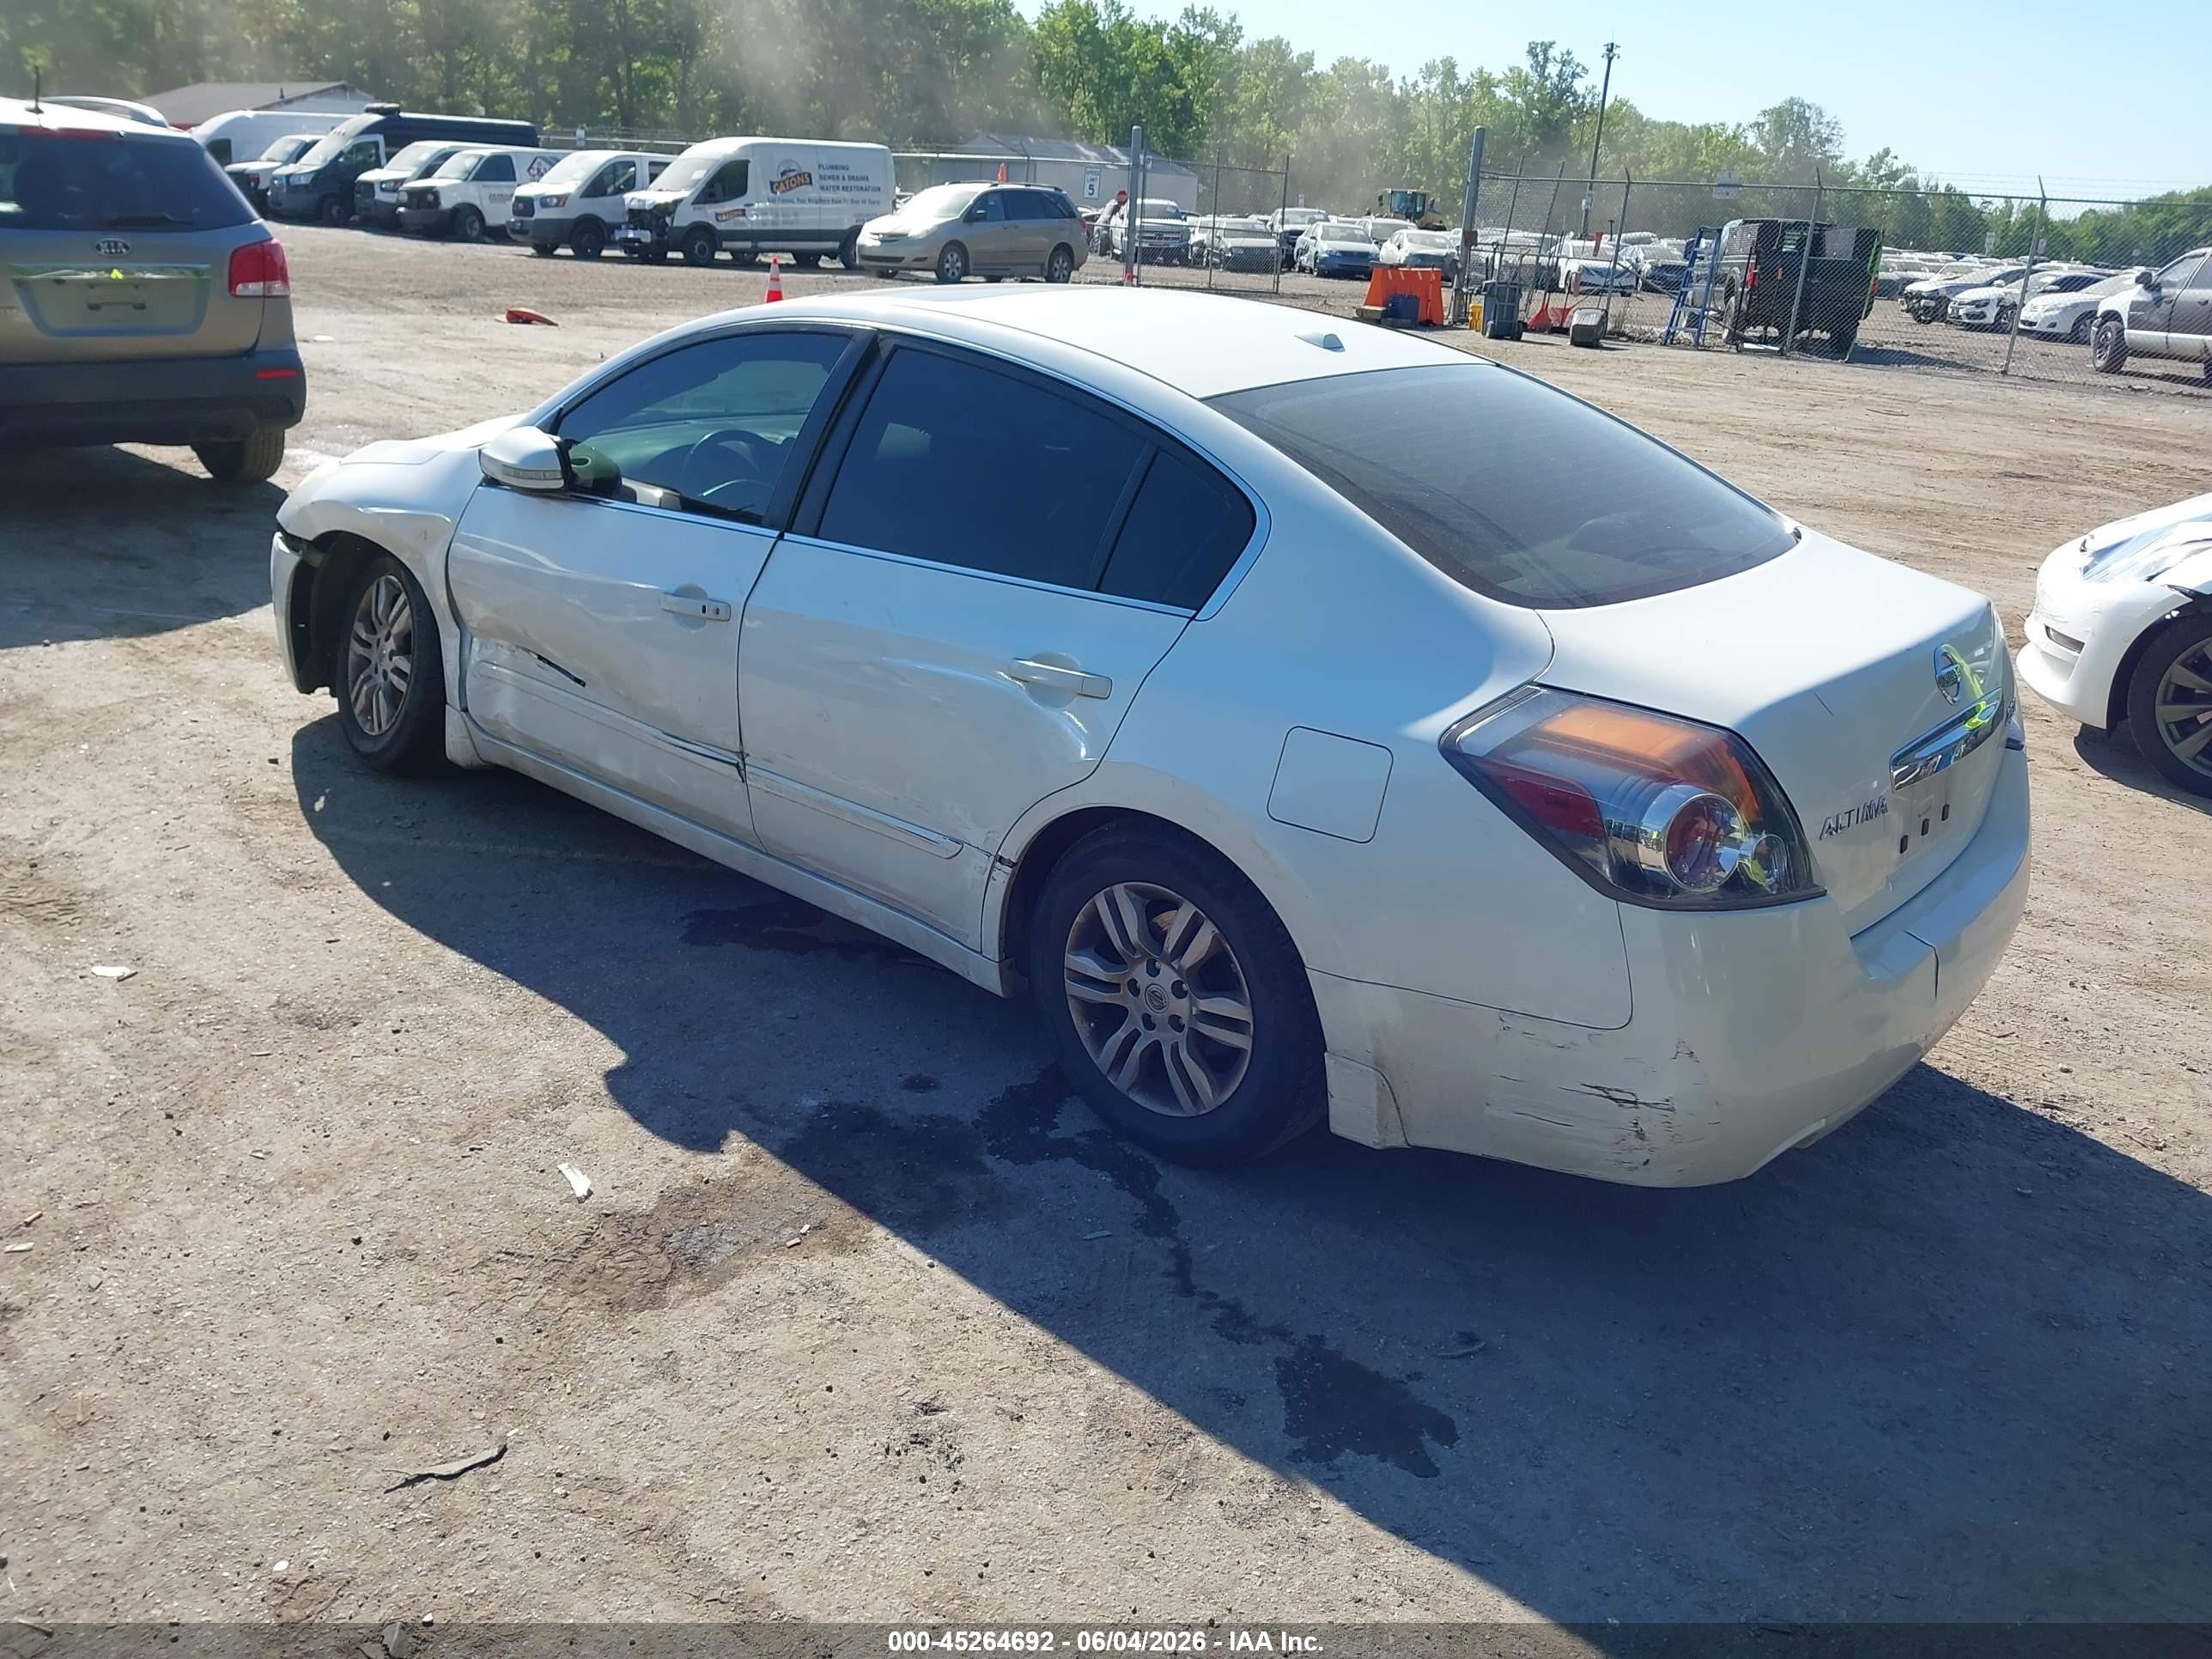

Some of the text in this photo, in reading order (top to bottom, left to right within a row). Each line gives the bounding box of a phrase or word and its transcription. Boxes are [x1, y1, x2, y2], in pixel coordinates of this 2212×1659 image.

[1088, 184, 1095, 196] 5
[98, 240, 129, 255] KIA
[1820, 796, 1888, 840] ALTIMA
